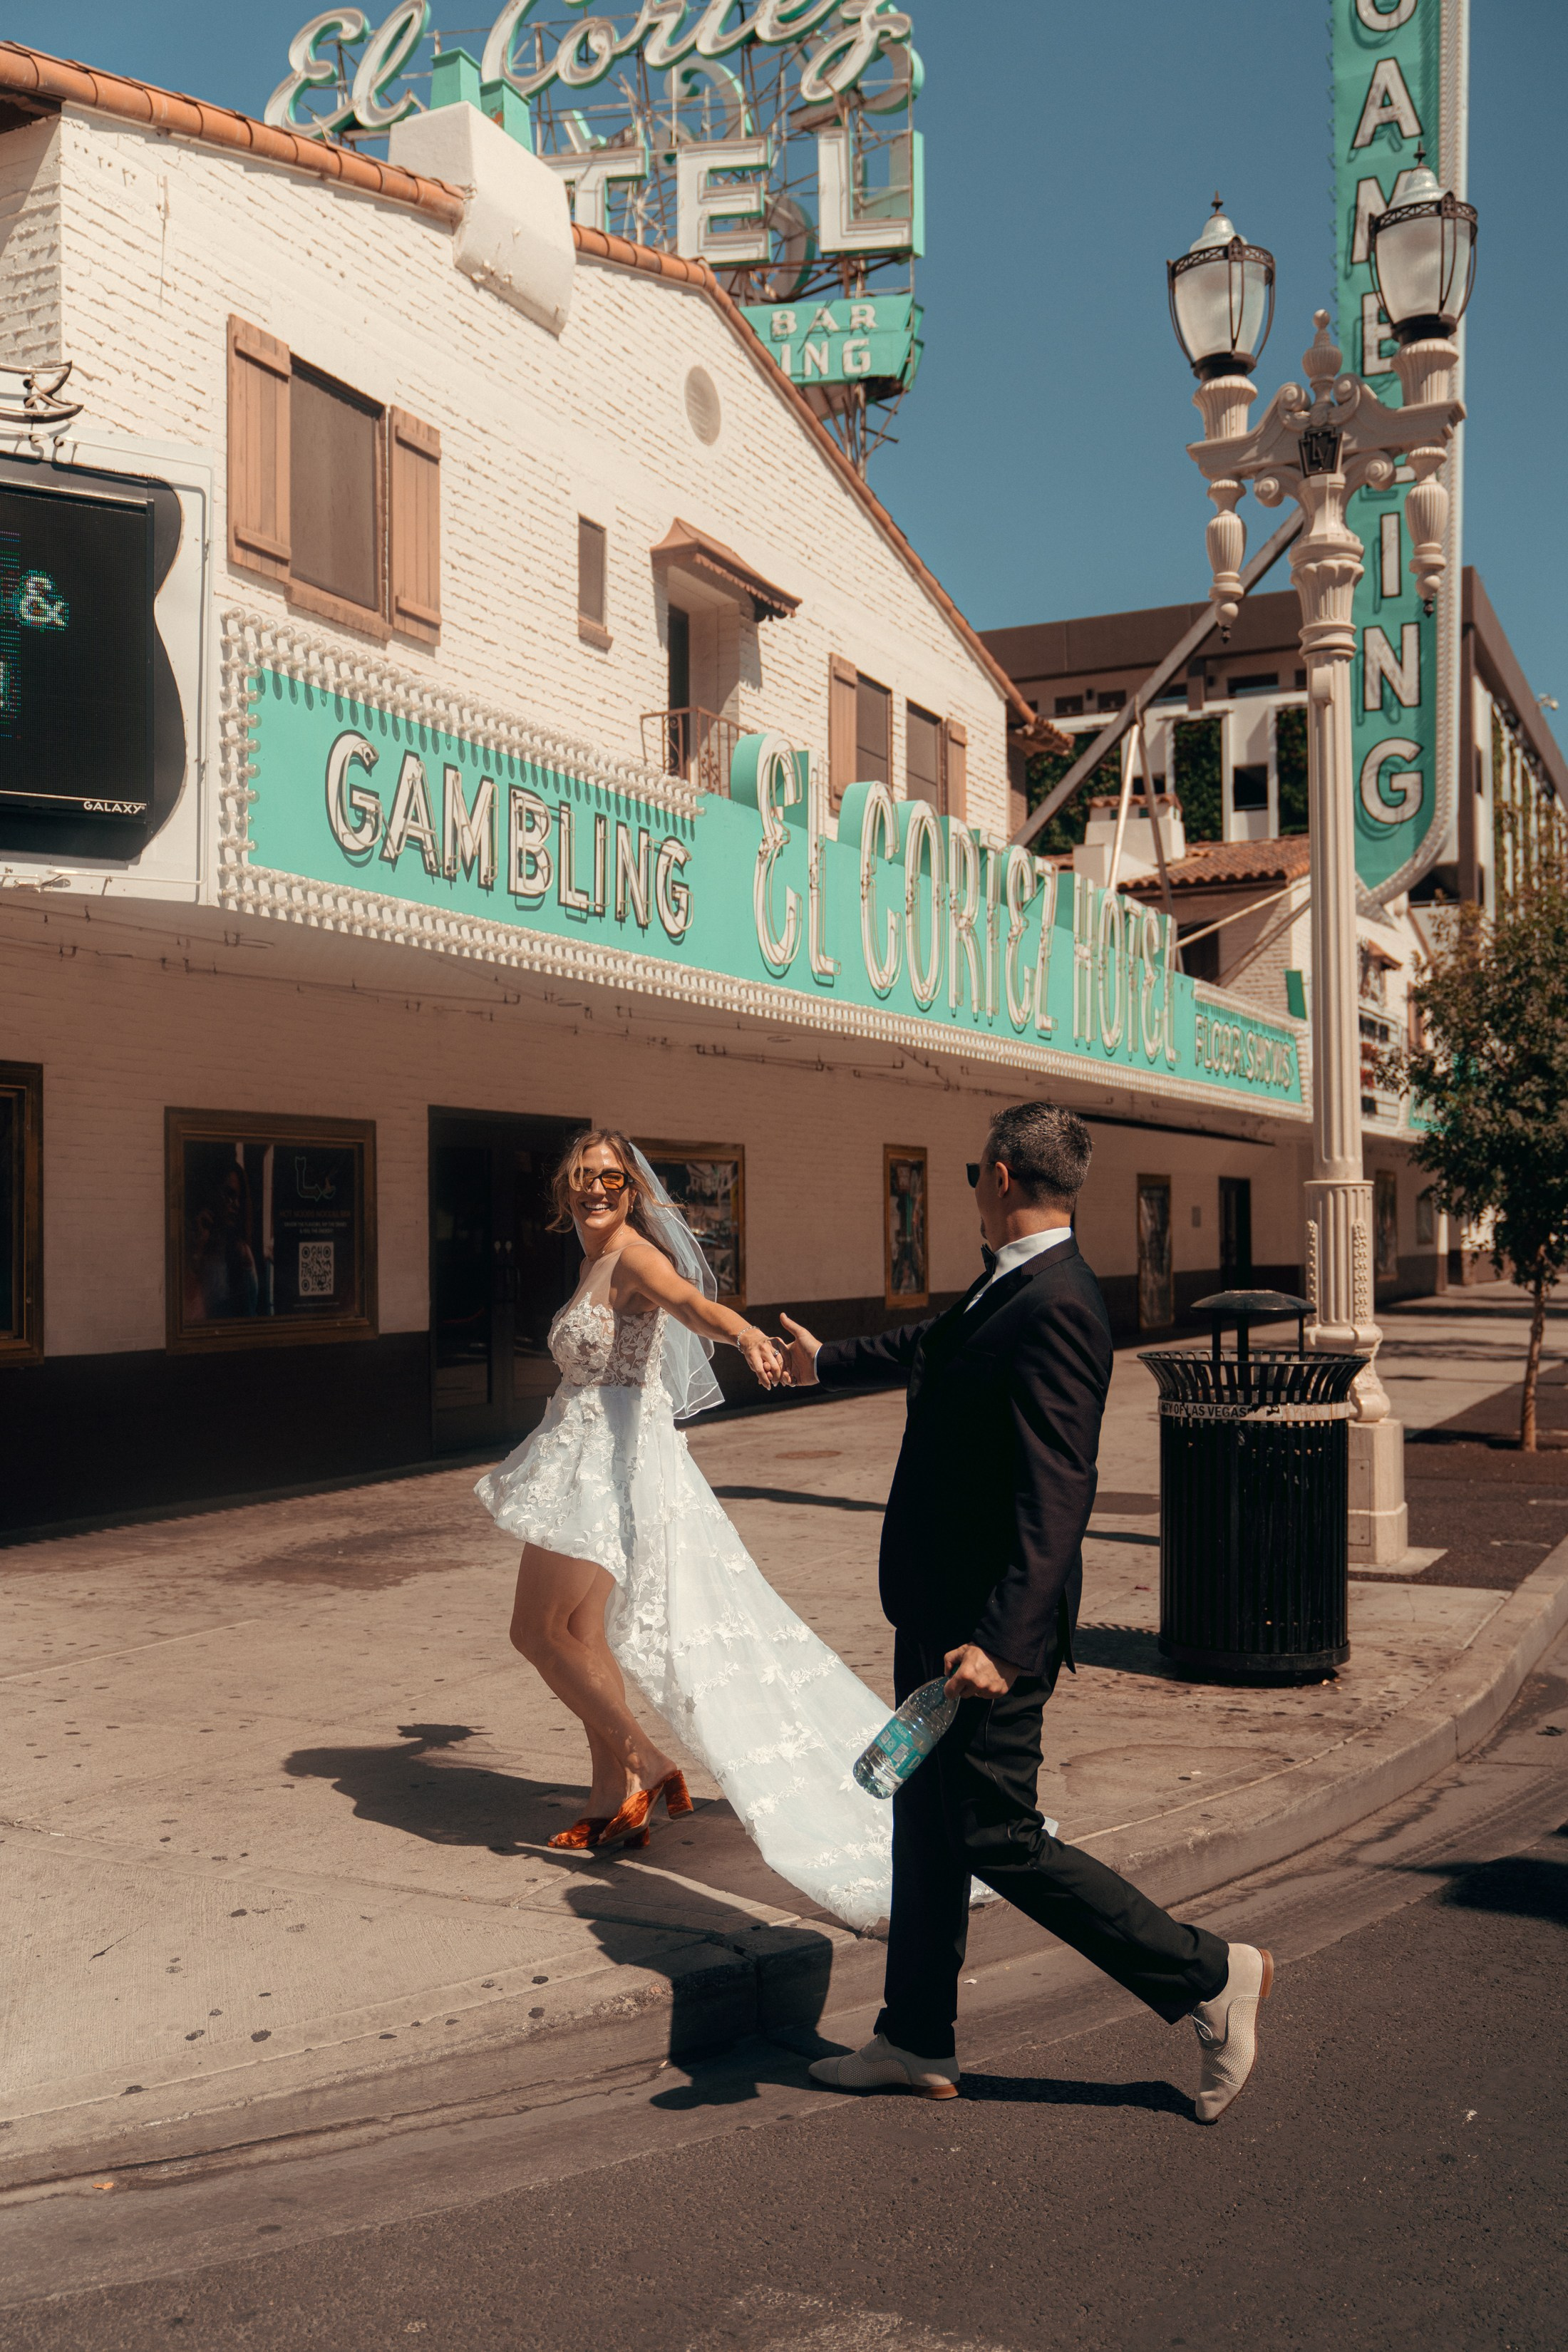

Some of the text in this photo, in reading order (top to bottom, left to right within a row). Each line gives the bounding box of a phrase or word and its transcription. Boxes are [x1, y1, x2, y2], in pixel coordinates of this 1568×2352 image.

[264, 0, 430, 137] El
[770, 303, 879, 337] BAR
[19, 570, 68, 629] &
[83, 800, 142, 814] GALAXY
[325, 728, 694, 938] GAMBLING
[753, 732, 1181, 1062] EL CORTEZ HOTEL
[1186, 1405, 1205, 1417] LAS
[1208, 1406, 1247, 1418] VEGAS
